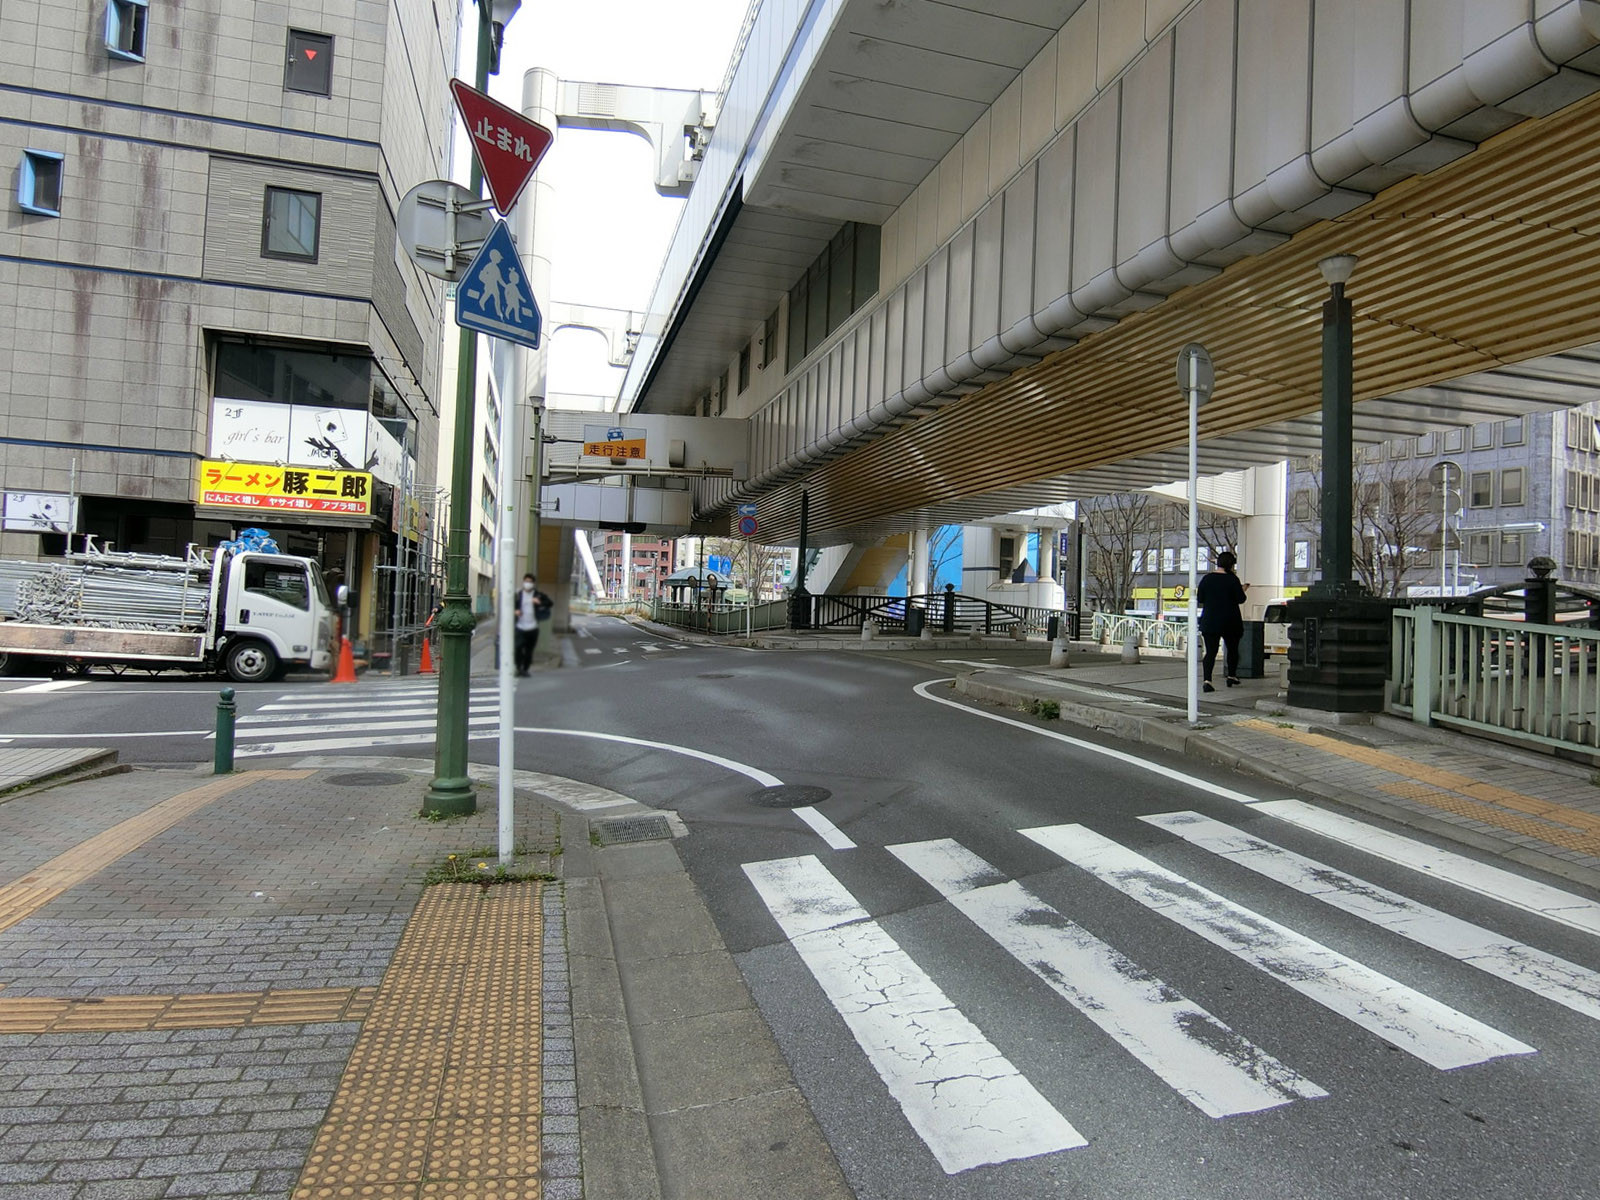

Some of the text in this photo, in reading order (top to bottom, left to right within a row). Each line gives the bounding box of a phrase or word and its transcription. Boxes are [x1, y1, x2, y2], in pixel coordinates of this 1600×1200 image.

[474, 116, 533, 162] 止まれ
[264, 430, 285, 444] bar
[589, 444, 641, 458] 走行注意
[205, 493, 260, 505] にんにく増し
[269, 497, 313, 509] ヤサイ増し
